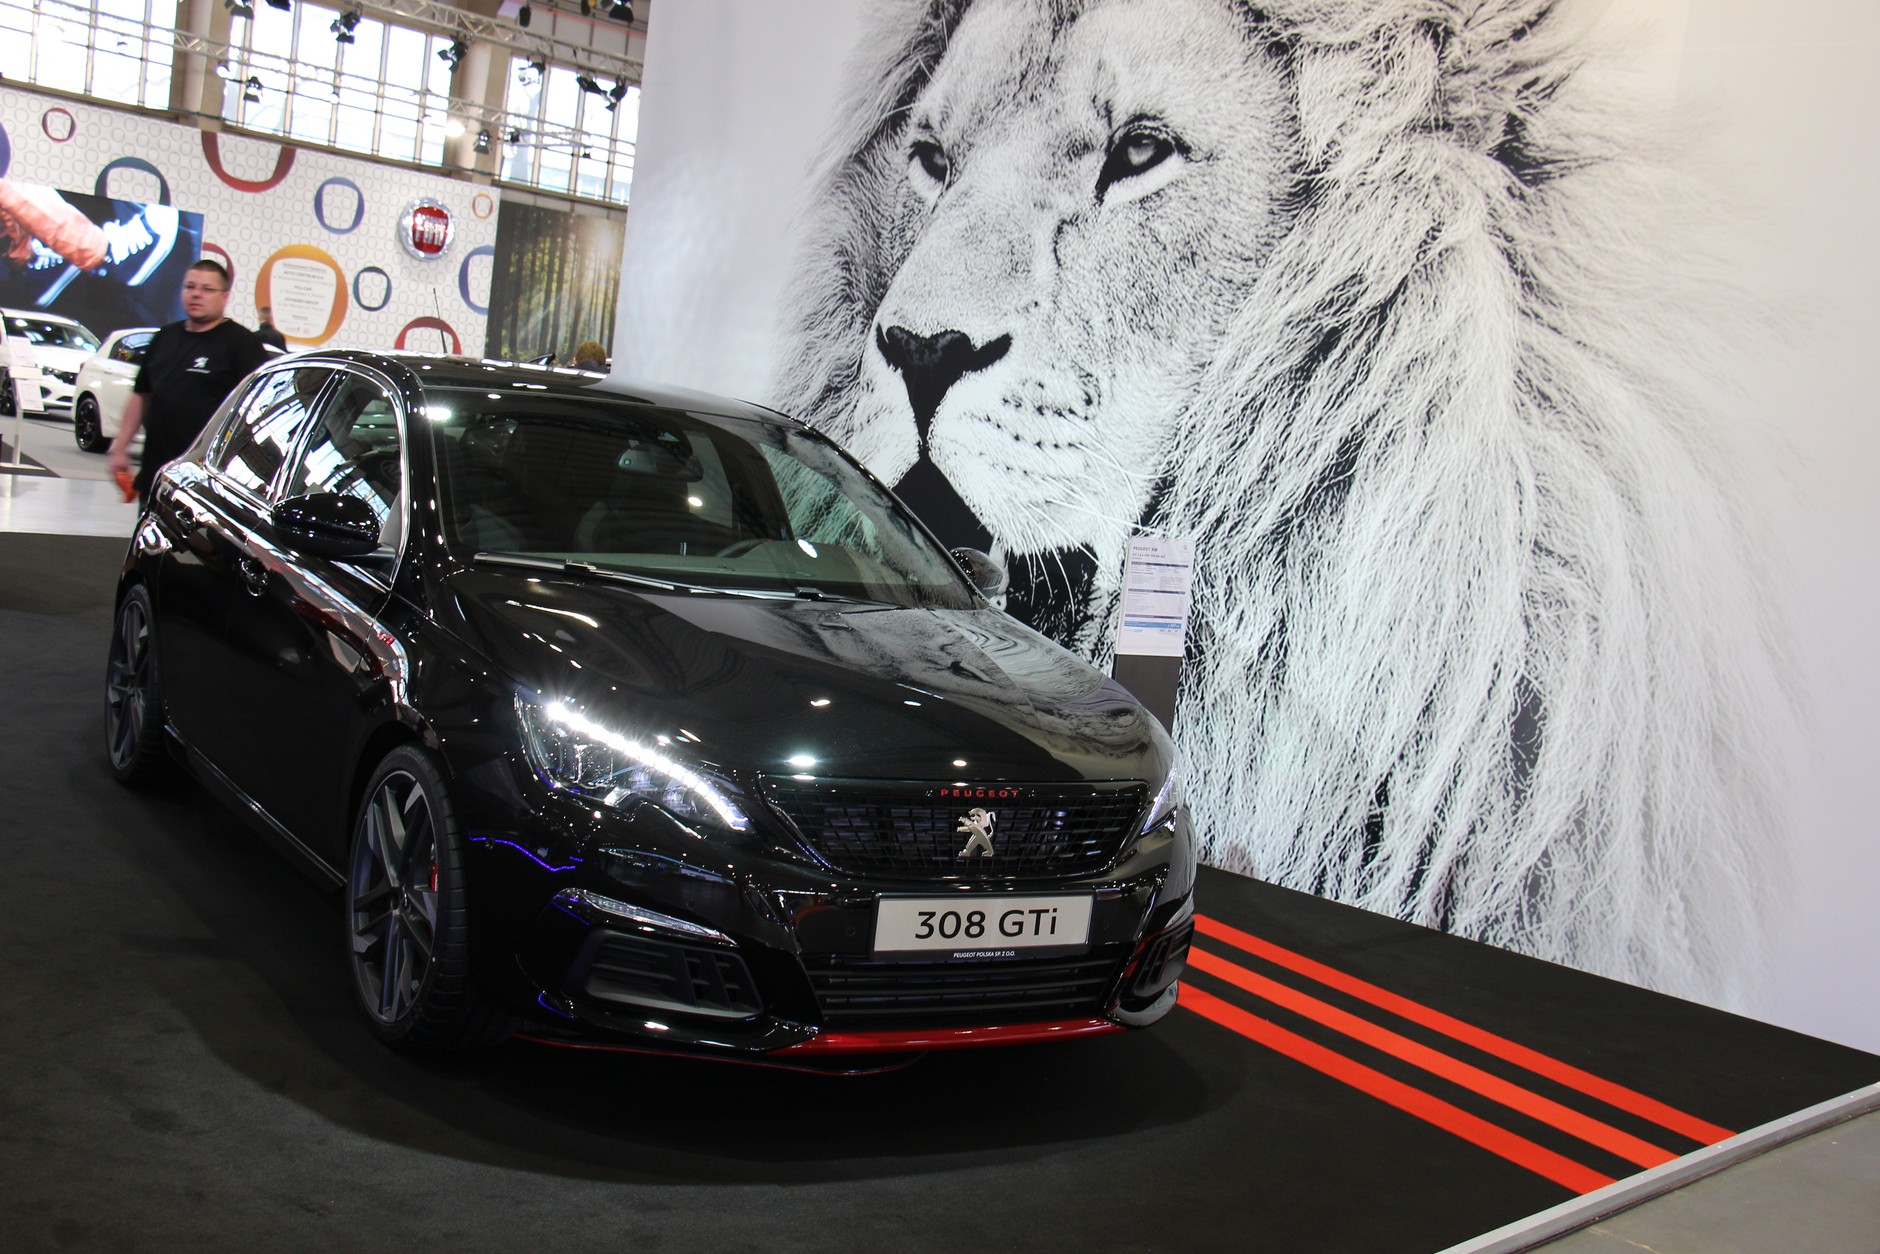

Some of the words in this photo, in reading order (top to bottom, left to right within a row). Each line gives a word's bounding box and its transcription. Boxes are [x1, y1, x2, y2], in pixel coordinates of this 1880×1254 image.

[940, 788, 1019, 798] PEUGEOT
[914, 910, 987, 940] 308
[998, 907, 1058, 938] GTi
[953, 951, 976, 959] PEUGEOT
